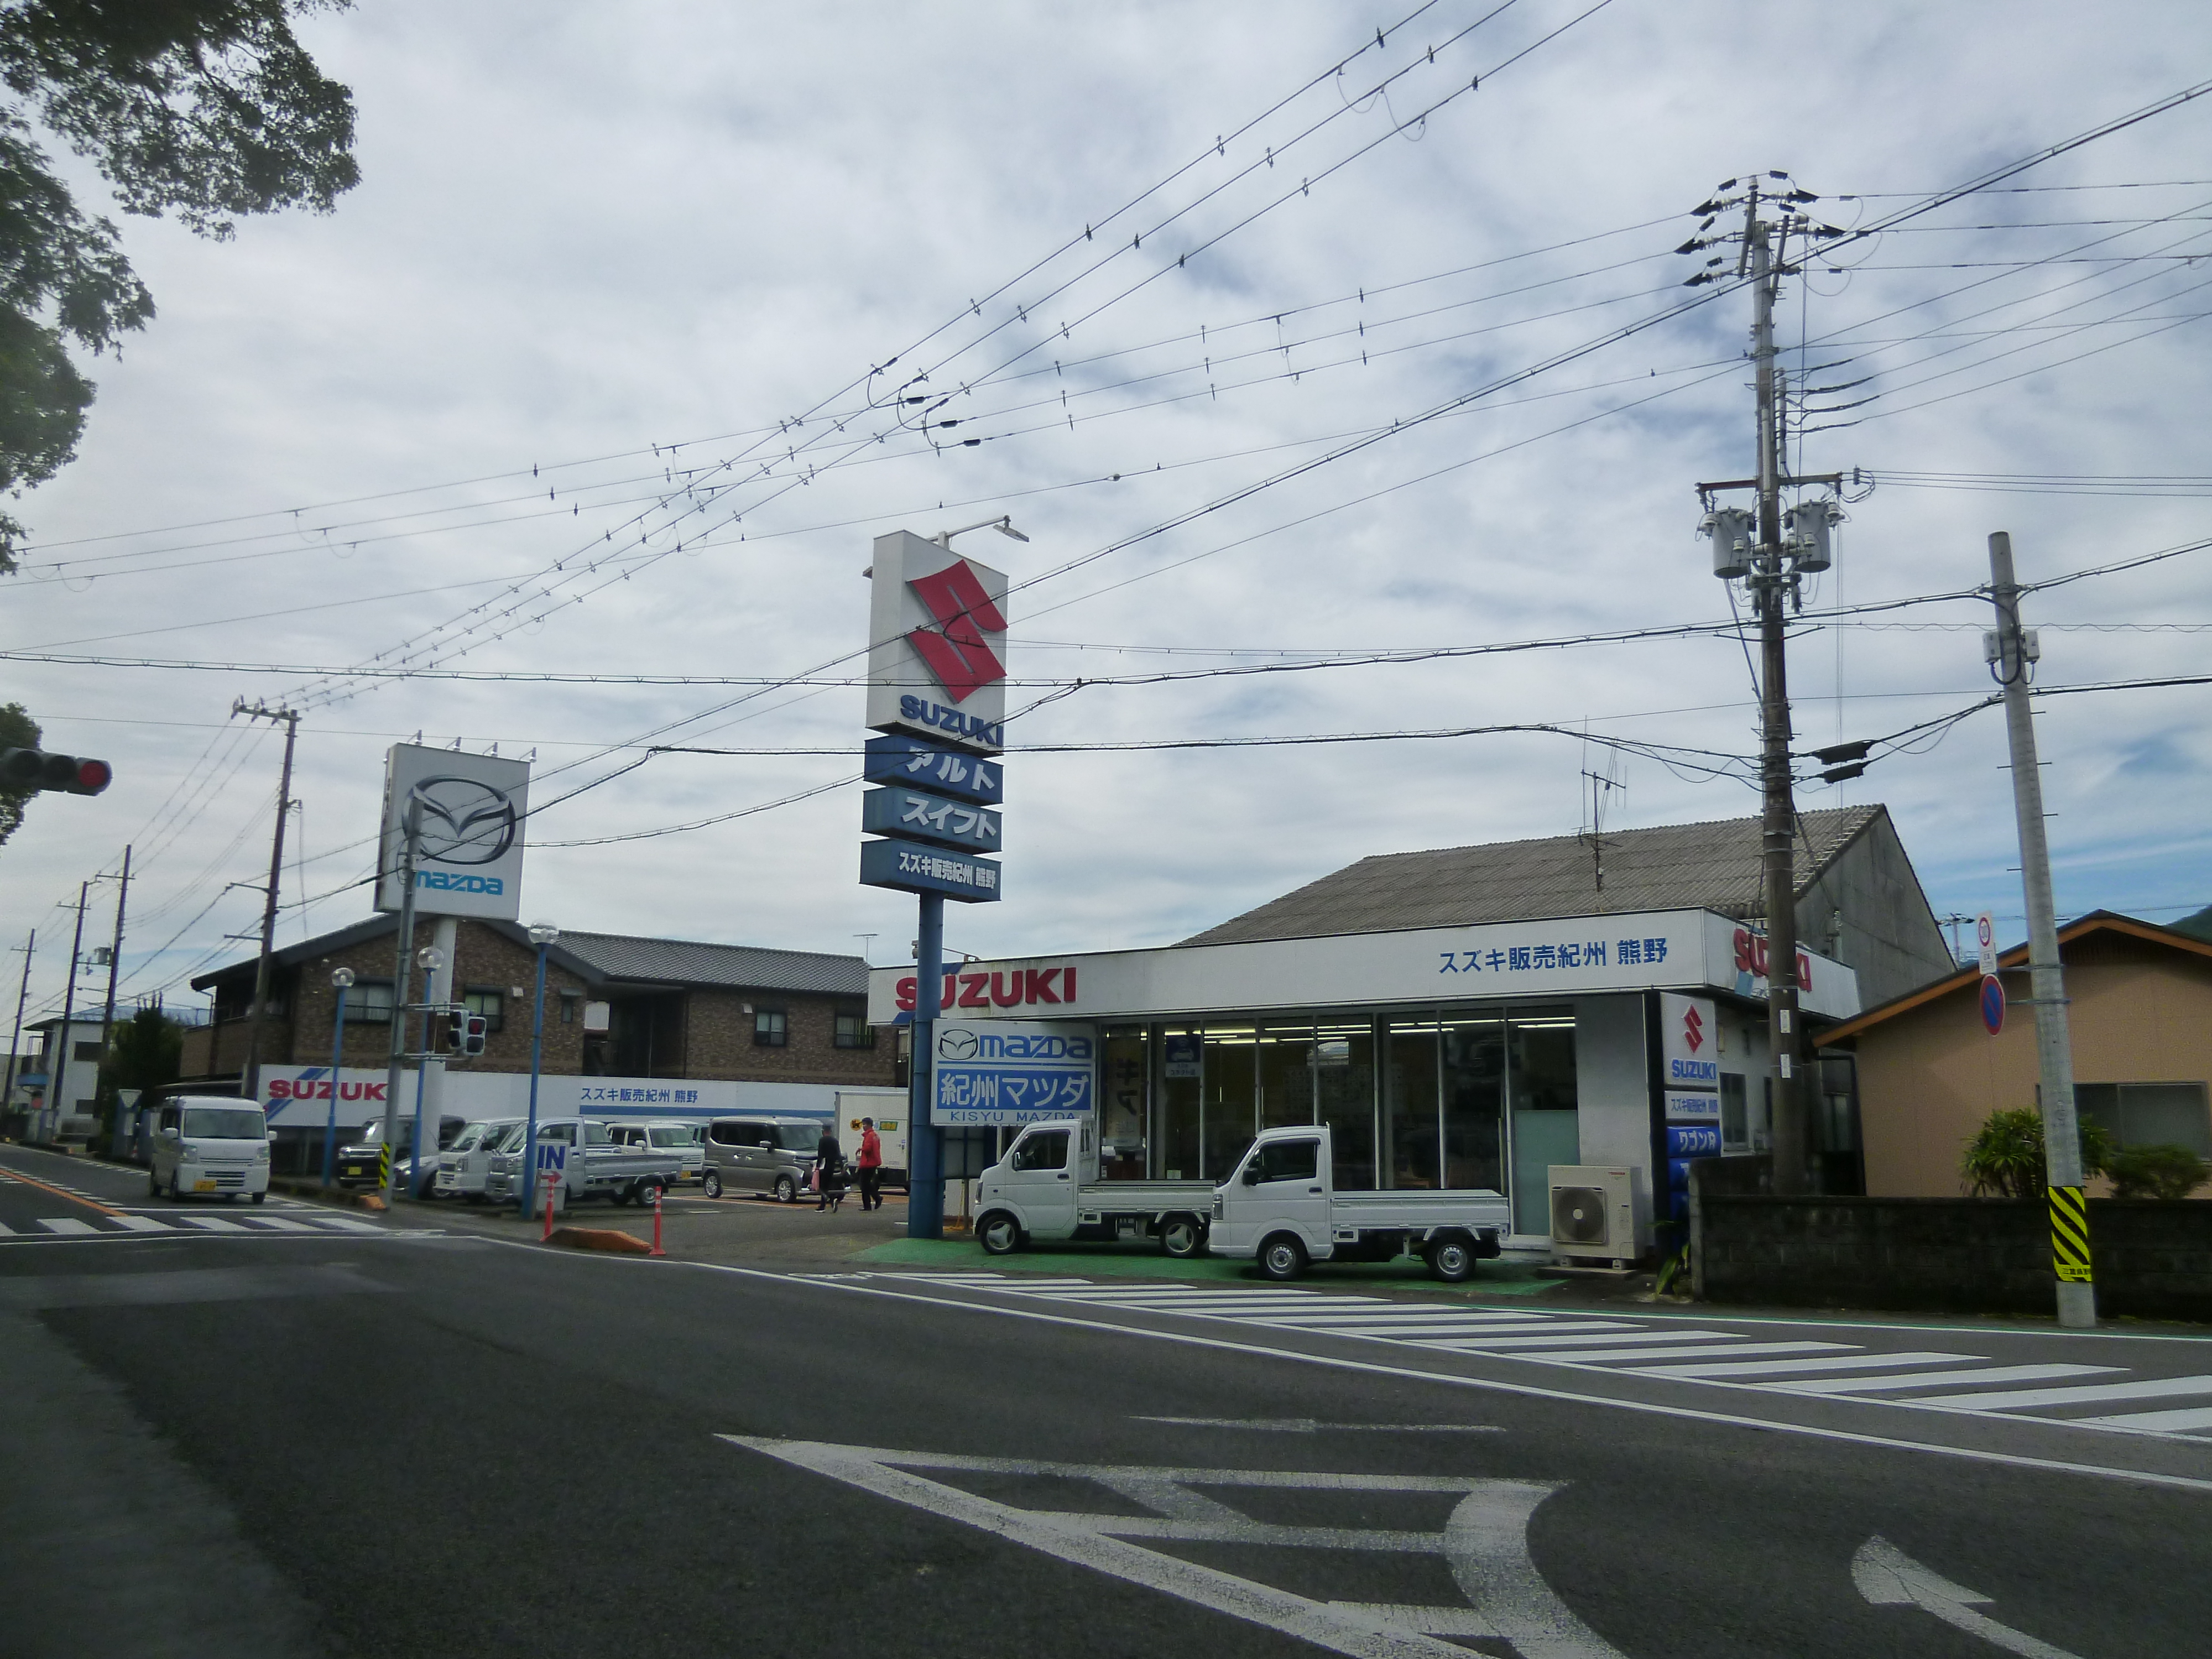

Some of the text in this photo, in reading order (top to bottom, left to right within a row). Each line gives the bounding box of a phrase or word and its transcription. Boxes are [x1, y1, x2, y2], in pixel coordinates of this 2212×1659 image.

[900, 695, 1003, 746] SUZUKI
[905, 746, 995, 791] アルト
[901, 796, 997, 839] スイフト
[1439, 937, 1668, 973] スズキ販売紀州 熊野
[979, 1035, 1092, 1058] mazda
[1671, 1059, 1717, 1080] SUZUKI
[269, 1079, 388, 1101] SUZUK
[940, 1072, 1089, 1107] 紀州マツダ
[951, 1112, 1076, 1121] KISYU MAZDA
[1678, 1130, 1716, 1152] ワゴンR
[538, 1145, 566, 1170] IN
